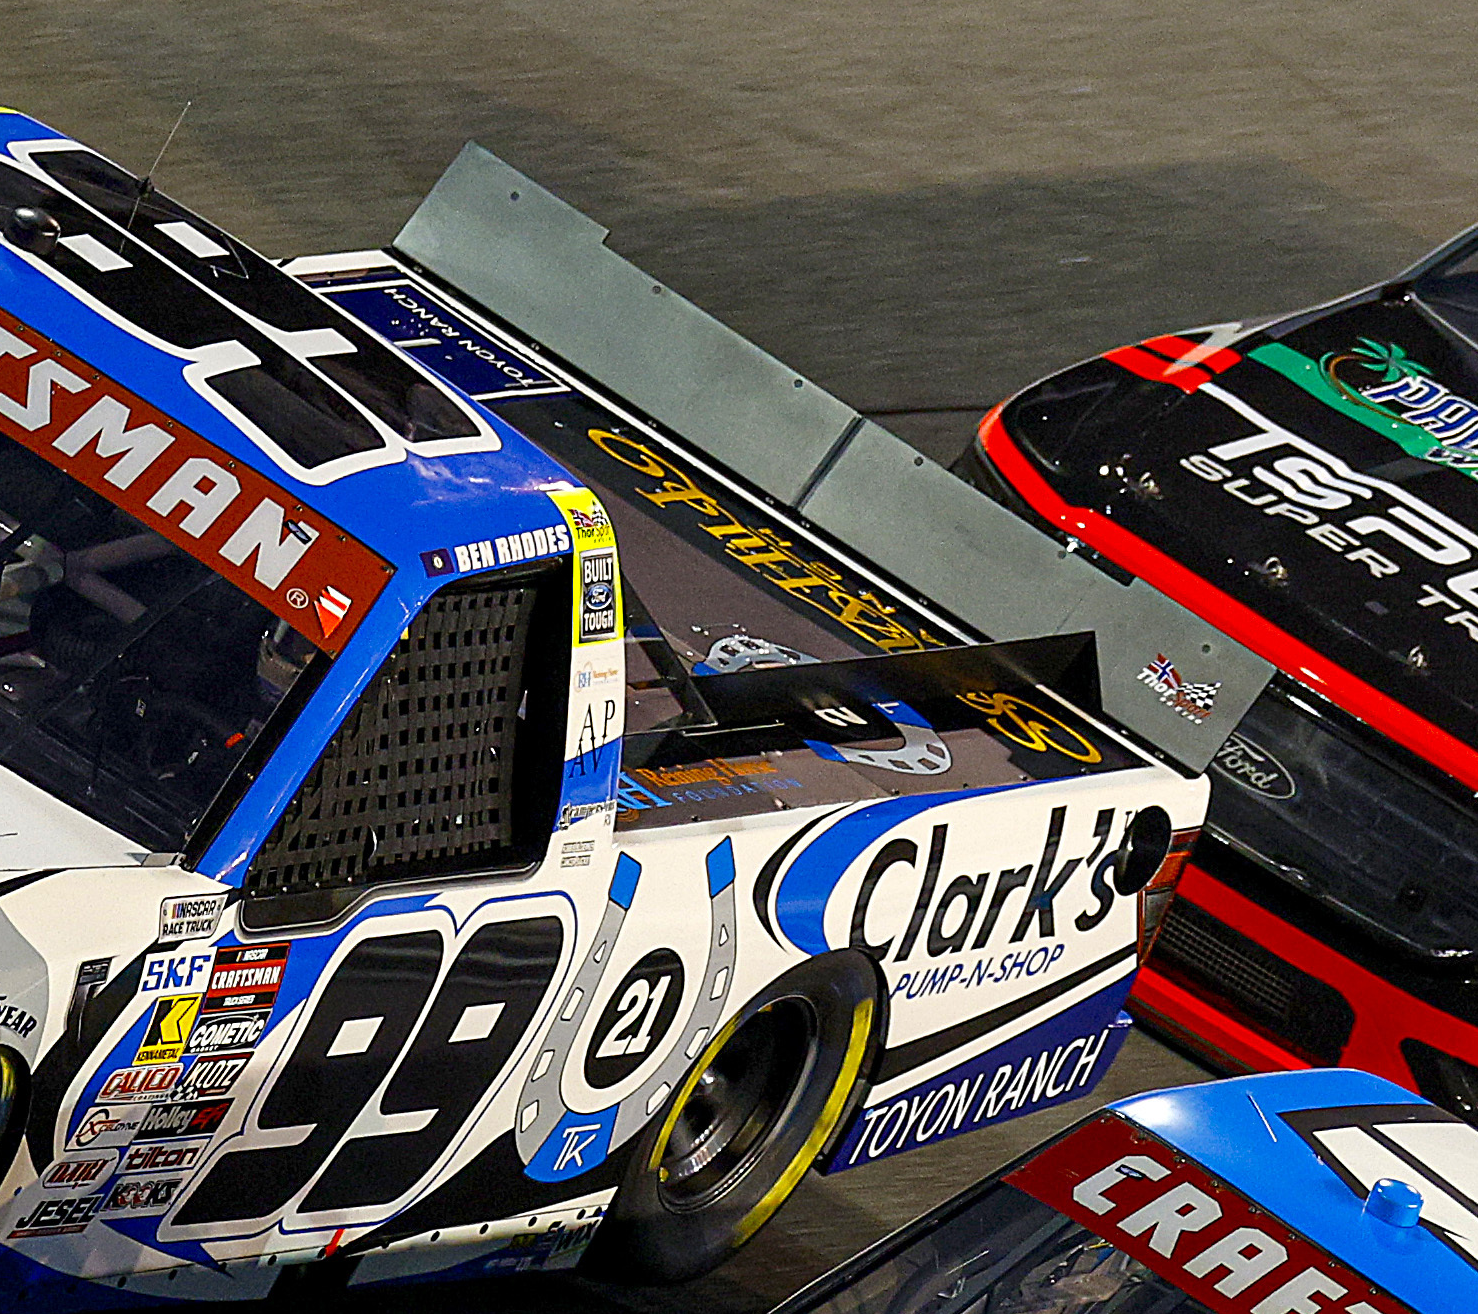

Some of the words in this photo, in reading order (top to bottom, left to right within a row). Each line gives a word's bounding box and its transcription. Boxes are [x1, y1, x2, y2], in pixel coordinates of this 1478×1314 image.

[1177, 455, 1407, 578] SUPER
[454, 542, 495, 574] BEN
[497, 523, 570, 566] RHODES
[584, 557, 612, 584] BUILT
[584, 609, 613, 632] TOUGH
[850, 806, 1127, 963] Clark's
[172, 900, 216, 919] NASCAR
[163, 922, 184, 936] RACE
[186, 919, 213, 934] TRUCK
[141, 955, 211, 991] SKF
[211, 967, 280, 990] CRAFTSMAN
[891, 943, 1066, 1001] PUMP-N-SHOP
[597, 976, 671, 1059] 21
[189, 1019, 264, 1048] COMETIC
[100, 1067, 180, 1098] CALICO
[159, 896, 574, 1241] 99
[187, 1059, 246, 1089] KLOTZ
[850, 1076, 986, 1164] TOYON
[977, 1030, 1110, 1115] RANCH
[141, 1107, 194, 1133] Holley
[126, 1147, 199, 1171] tilton
[17, 1196, 101, 1229] JESEL
